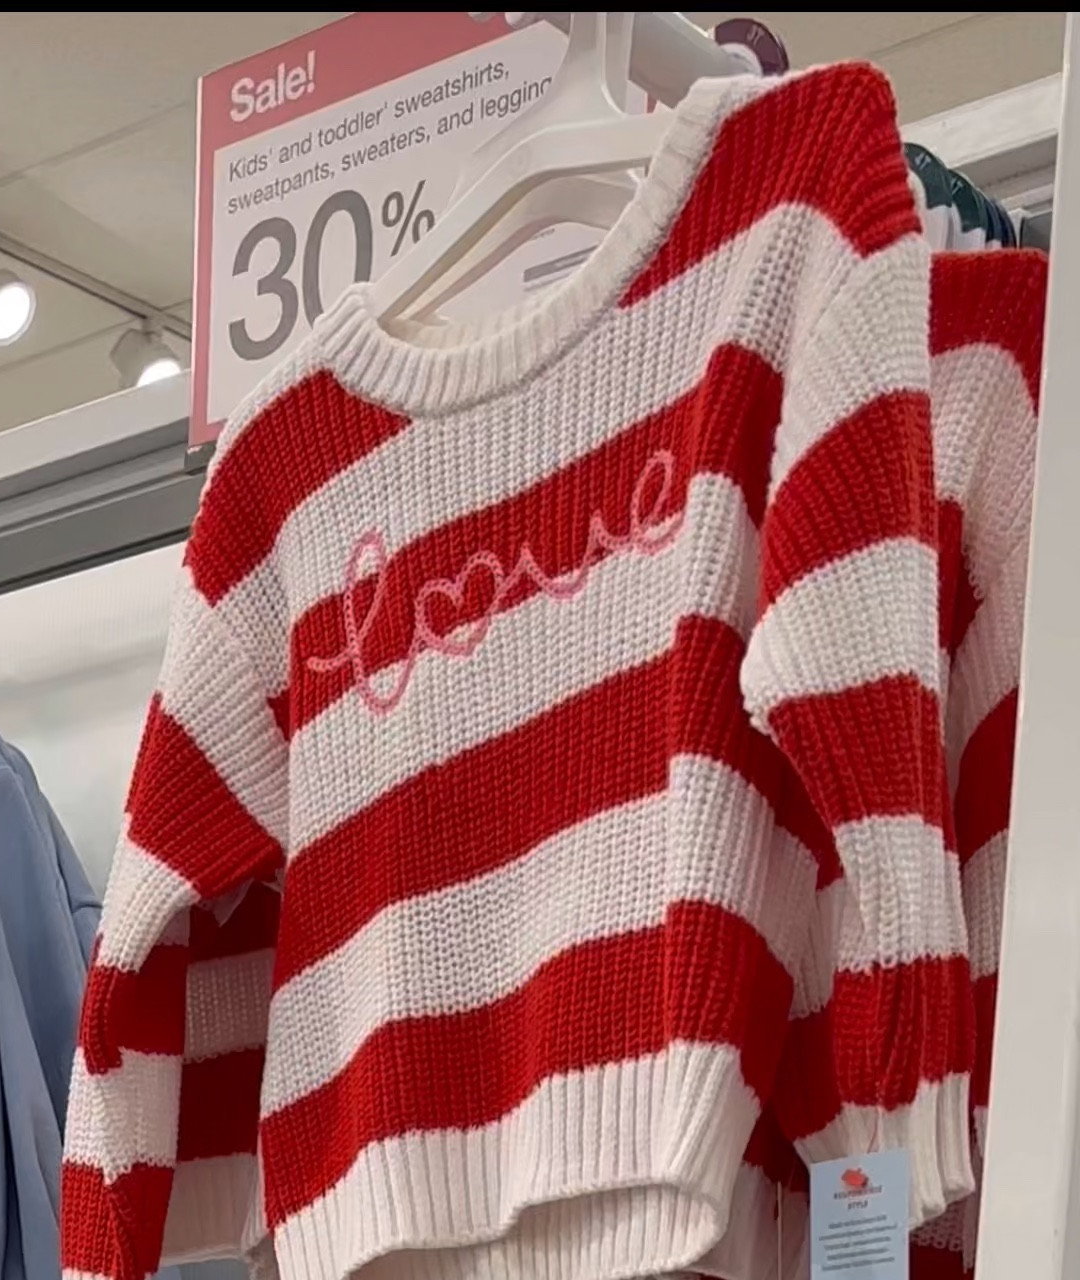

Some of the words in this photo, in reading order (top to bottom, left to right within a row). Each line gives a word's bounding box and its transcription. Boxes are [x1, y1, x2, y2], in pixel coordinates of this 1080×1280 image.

[230, 50, 316, 123] Sale!
[278, 132, 313, 164] and
[394, 61, 510, 119] sweatshirts,
[227, 161, 336, 215] sweatpants,
[341, 123, 431, 172] sweaters,
[437, 102, 474, 136] and
[307, 449, 689, 716] love
